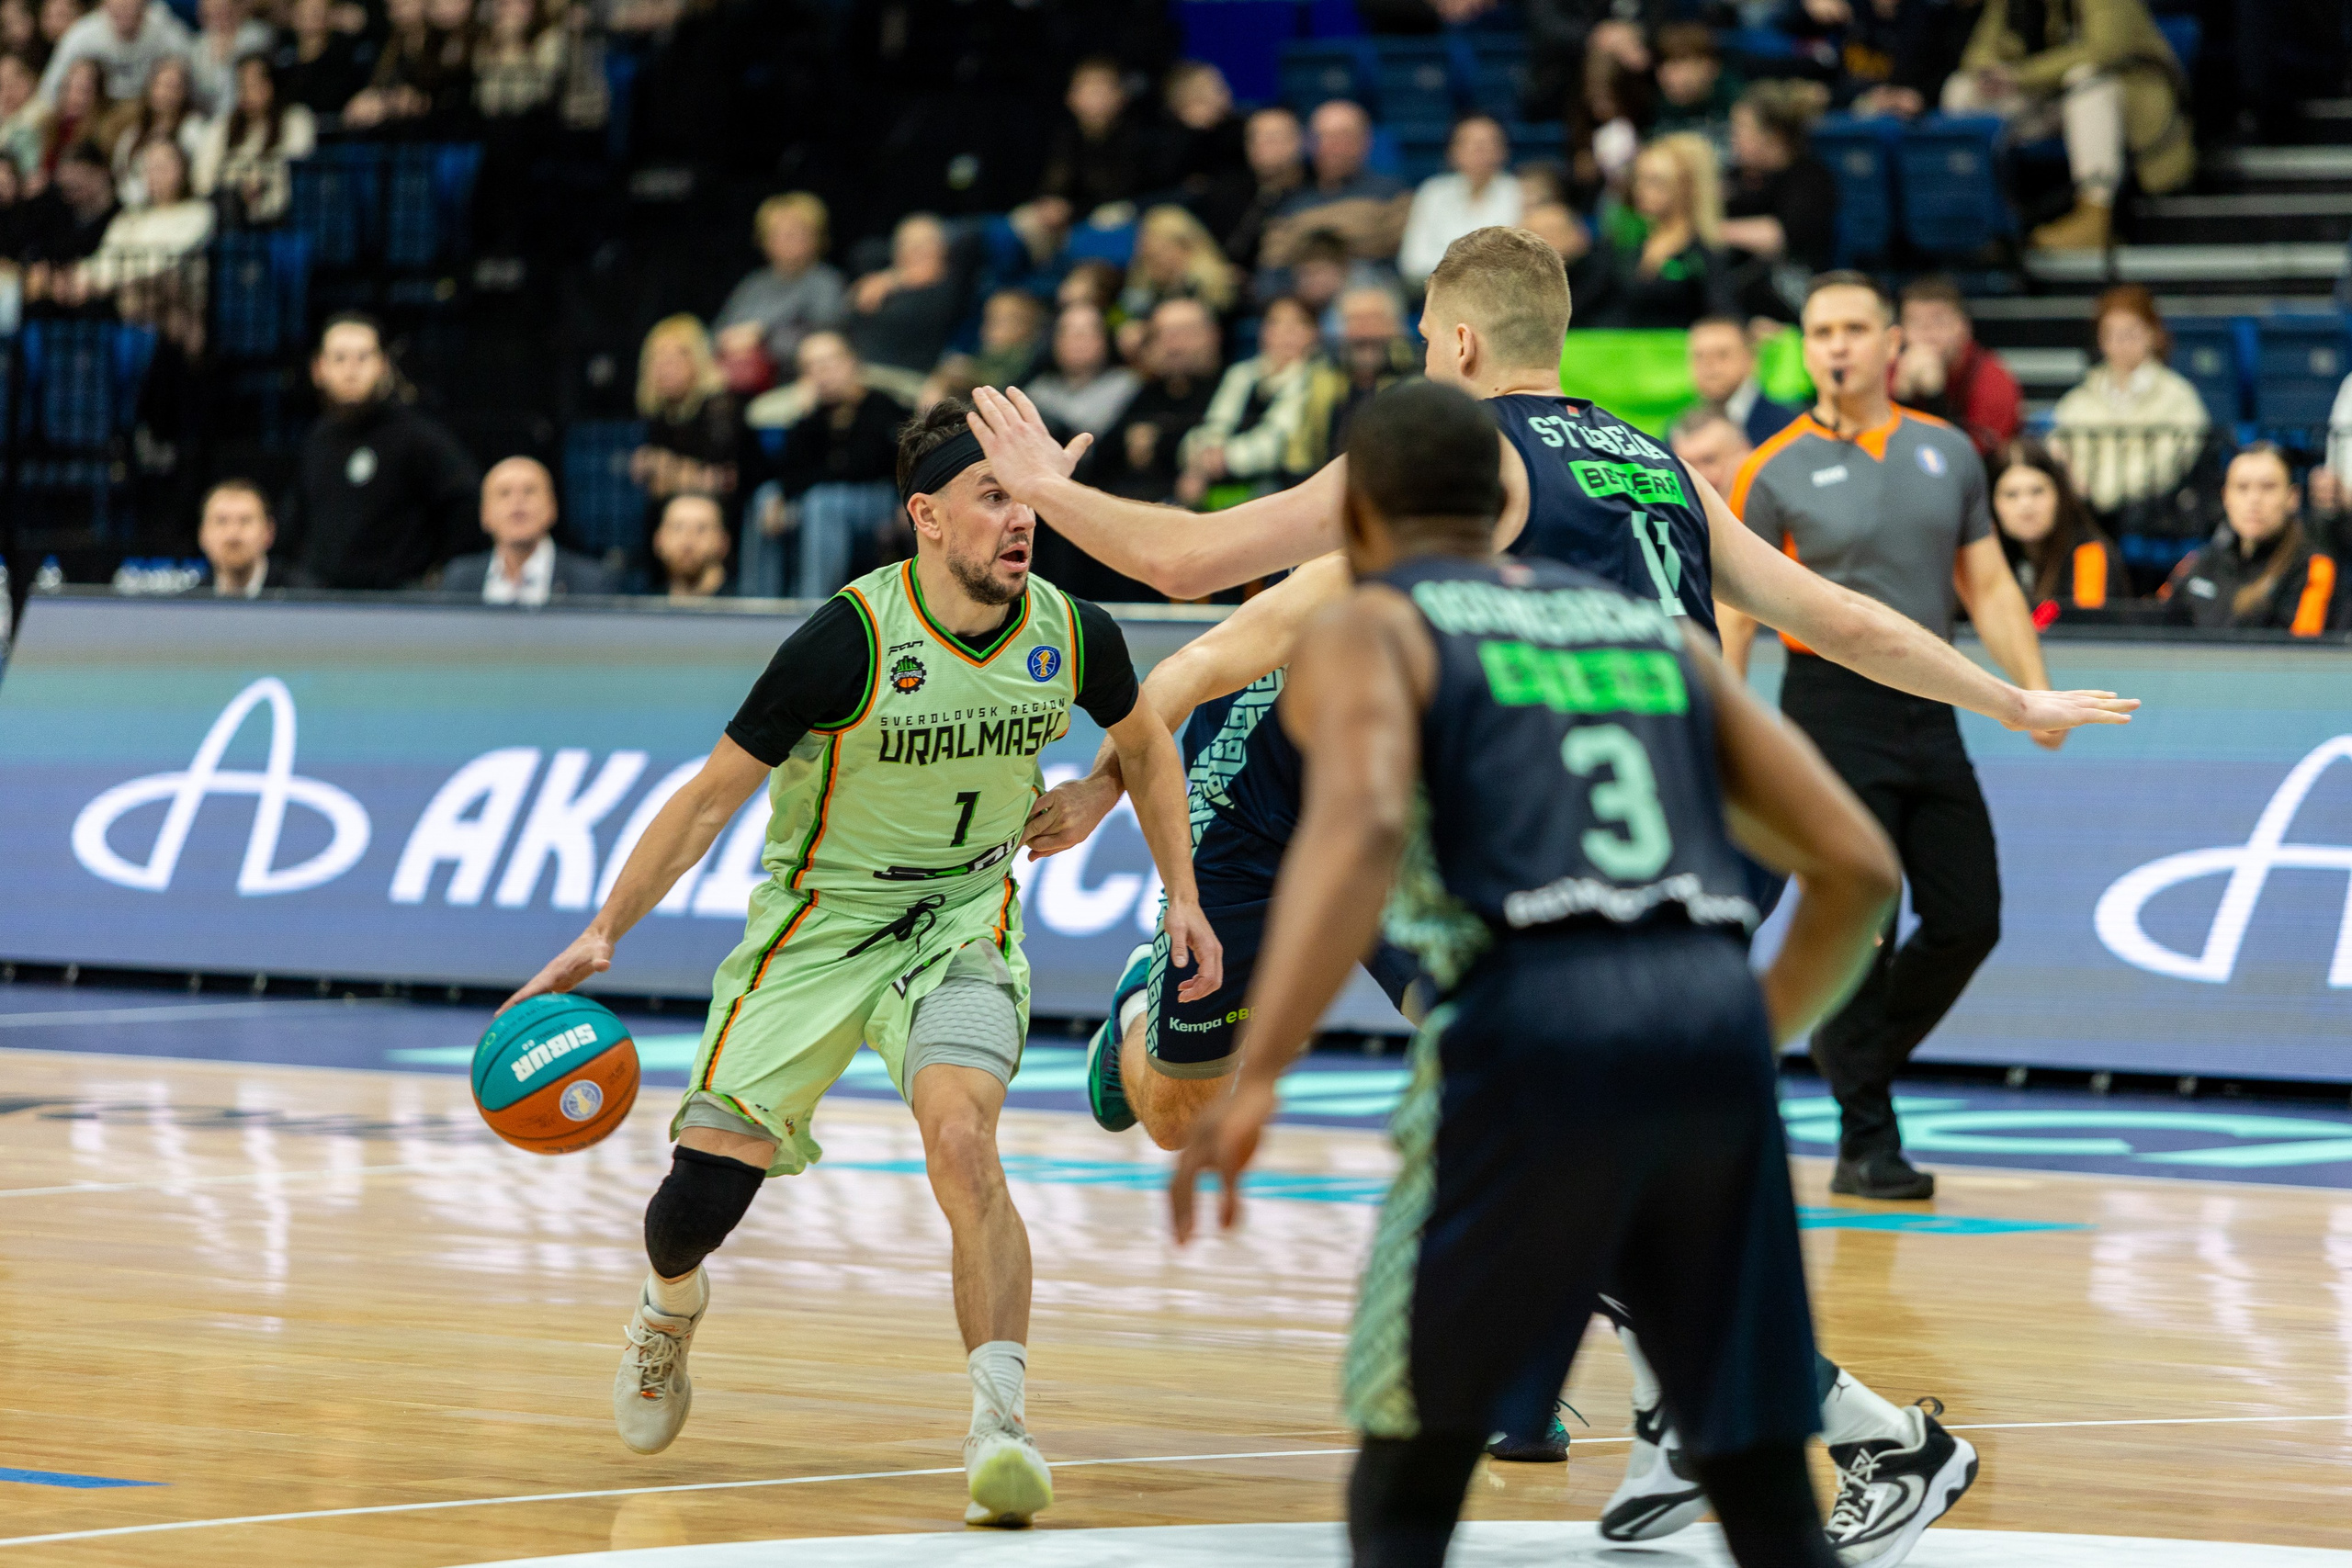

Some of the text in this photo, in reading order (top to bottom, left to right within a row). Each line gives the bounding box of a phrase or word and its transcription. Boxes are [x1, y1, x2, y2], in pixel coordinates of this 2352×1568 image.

[880, 697, 1065, 727] SVERDLOVSK REGION
[949, 790, 982, 848] 1
[1560, 722, 1674, 880] 3
[511, 1022, 598, 1082] SIBUR
[1169, 1016, 1222, 1033] Kempa
